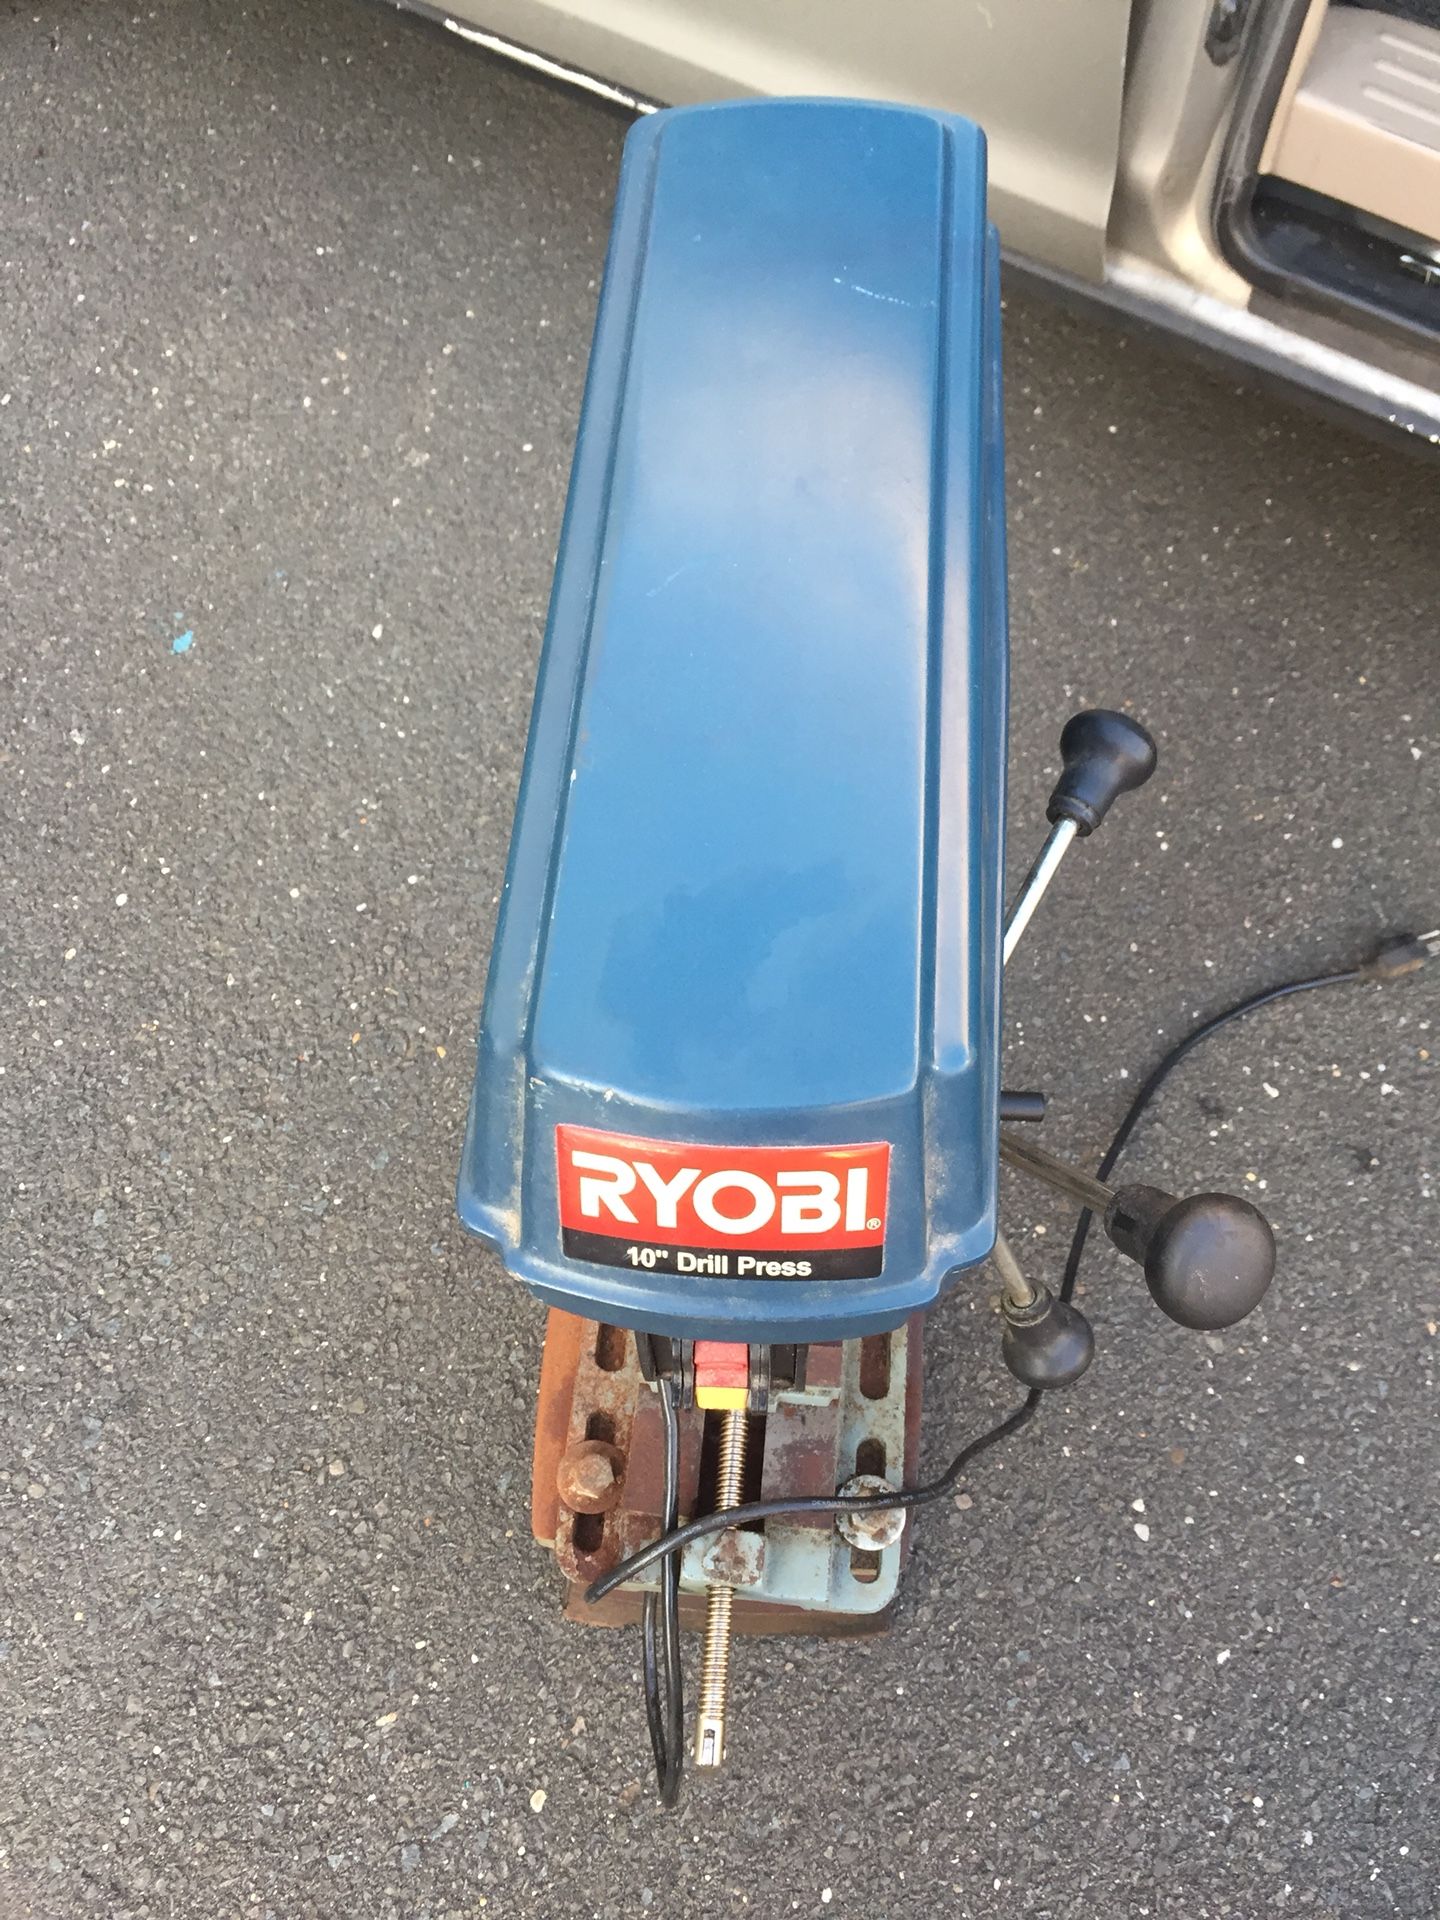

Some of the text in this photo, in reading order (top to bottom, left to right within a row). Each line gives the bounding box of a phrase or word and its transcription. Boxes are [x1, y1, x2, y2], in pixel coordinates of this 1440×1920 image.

[571, 1150, 868, 1235] RYOBI
[626, 1246, 813, 1277] 10" Drill Press
